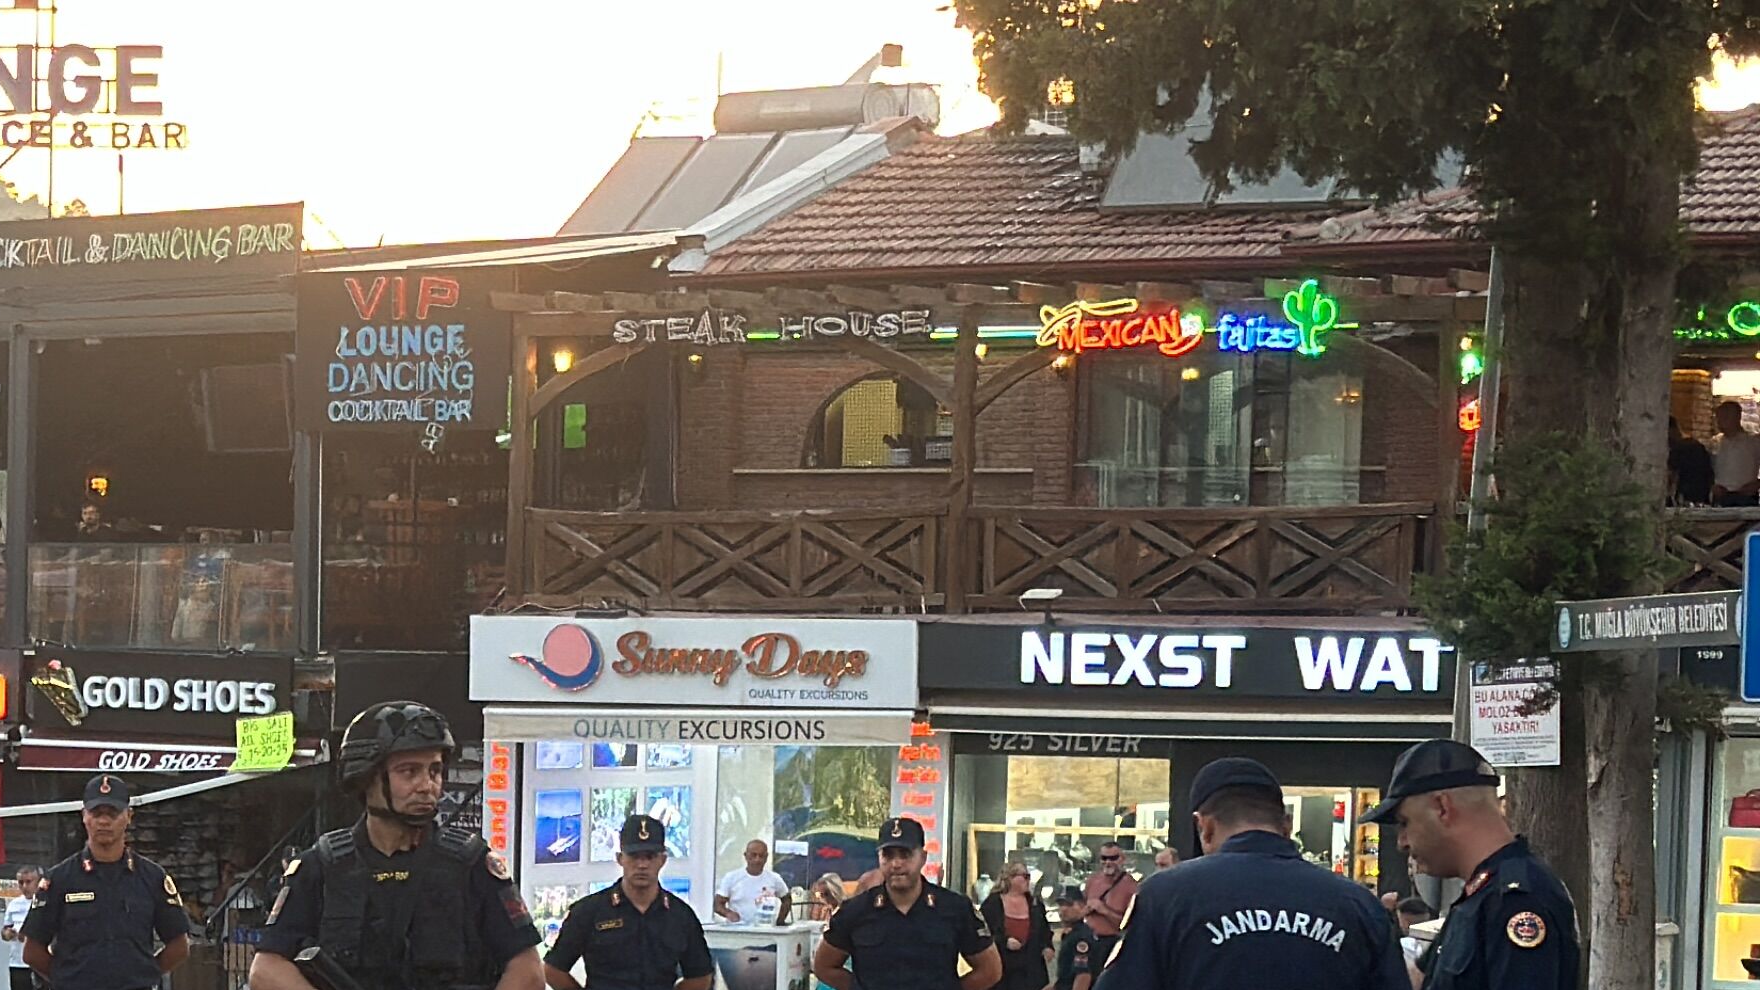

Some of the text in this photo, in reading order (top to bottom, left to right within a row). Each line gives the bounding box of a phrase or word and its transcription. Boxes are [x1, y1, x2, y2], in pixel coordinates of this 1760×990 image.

[69, 122, 92, 148] &
[111, 122, 186, 149] BAR
[84, 233, 108, 266] &
[236, 221, 295, 254] BAR
[343, 275, 460, 320] VIP
[337, 324, 466, 357] LOUNGE
[613, 308, 930, 345] STEAK HOUSE
[1056, 308, 1194, 355] MEXICAN
[327, 360, 475, 393] DANCING
[327, 399, 473, 423] COCKTAIL BAR
[611, 630, 870, 689] Sunny Days
[1020, 631, 1247, 688] NEXST
[82, 674, 277, 715] GOLD SHOES
[748, 689, 869, 701] QUALITY EXCURSIONS
[573, 719, 826, 741] QUALITY EXCURSIONS
[987, 731, 1141, 754] 925 SILVER
[98, 750, 152, 770] GOLD
[154, 751, 222, 770] SHOES
[1205, 908, 1347, 953] JANDARMA
